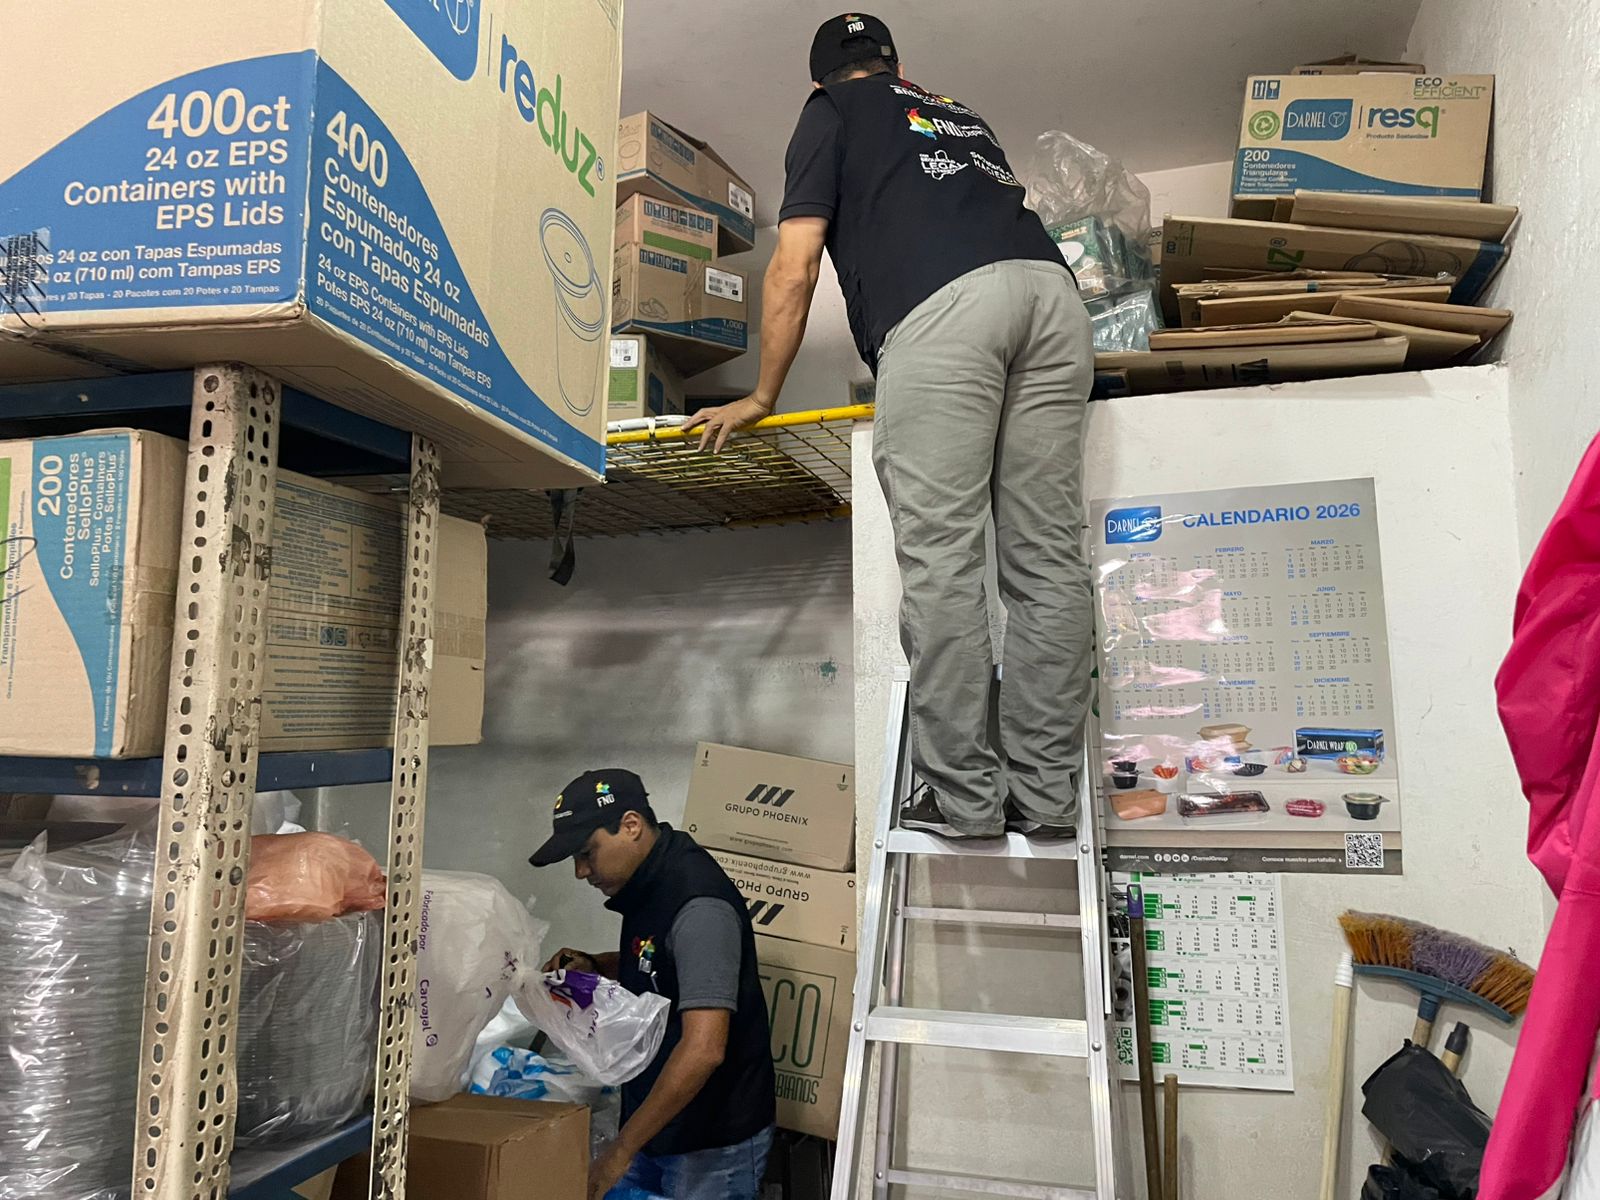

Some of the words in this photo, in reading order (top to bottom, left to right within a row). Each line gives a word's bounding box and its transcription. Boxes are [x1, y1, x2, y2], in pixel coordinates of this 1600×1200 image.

[848, 22, 865, 33] FND
[1415, 77, 1443, 87] ECO
[147, 88, 291, 139] 400ct
[932, 118, 964, 137] FND
[1287, 111, 1327, 128] DARNEL
[145, 146, 177, 171] 24
[186, 149, 219, 168] oz
[229, 139, 288, 166] EPS
[326, 111, 389, 187] 400
[1244, 150, 1270, 162] 200
[1242, 162, 1296, 170] Contenedores
[1243, 169, 1289, 177] Triangulares
[64, 177, 216, 206] Containers
[224, 170, 286, 196] with
[156, 202, 215, 230] EPS
[223, 201, 284, 227] Lids
[325, 157, 438, 260] Contenedores
[57, 249, 75, 264] 24
[79, 250, 98, 263] oz
[101, 248, 130, 262] con
[135, 244, 182, 262] Tapas
[187, 240, 282, 261] Espumadas
[323, 185, 420, 274] Espumados
[424, 262, 441, 289] 24
[445, 281, 461, 303] oz
[53, 271, 72, 283] oz
[75, 267, 108, 285] (710
[110, 265, 134, 282] ml)
[138, 265, 174, 279] com
[178, 262, 243, 280] Tampas
[247, 259, 281, 275] EPS
[321, 222, 355, 258] con
[360, 241, 410, 294] Tapas
[413, 279, 490, 348] Espumadas
[67, 292, 78, 300] 20
[79, 290, 105, 301] Tapas
[112, 289, 124, 299] 20
[125, 288, 160, 298] Pacotes
[161, 288, 181, 297] com
[182, 286, 195, 296] 20
[195, 285, 223, 297] Potes
[231, 284, 243, 294] 20
[244, 283, 281, 295] Tampas
[318, 253, 332, 272] 24
[333, 266, 346, 281] oz
[348, 272, 369, 295] EPS
[371, 287, 418, 326] Containers
[419, 320, 436, 339] with
[437, 330, 453, 349] EPS
[453, 340, 470, 360] Lids
[317, 272, 348, 302] Potes
[349, 292, 370, 315] EPS
[371, 306, 383, 323] 24
[384, 317, 396, 331] oz
[397, 321, 415, 342] (710
[429, 344, 447, 362] com
[447, 352, 477, 381] Tampas
[476, 371, 492, 389] EPS
[37, 454, 63, 516] 200
[78, 456, 94, 541] SelloPlus
[93, 451, 106, 521] Containers
[104, 453, 117, 513] SelloPlus
[60, 453, 80, 580] Contenedores
[1183, 506, 1310, 528] CALENDARIO
[1316, 503, 1361, 519] 2026
[102, 515, 114, 554] Potes
[89, 526, 103, 588] SelloPlus
[1307, 740, 1329, 750] DARNEL
[596, 793, 615, 807] FND
[725, 803, 760, 817] GRUPO
[762, 810, 809, 826] PHOENIX
[766, 885, 810, 902] GRUPO
[420, 890, 434, 934] Fabricado
[418, 933, 427, 951] por
[419, 979, 432, 1032] Carvajal
